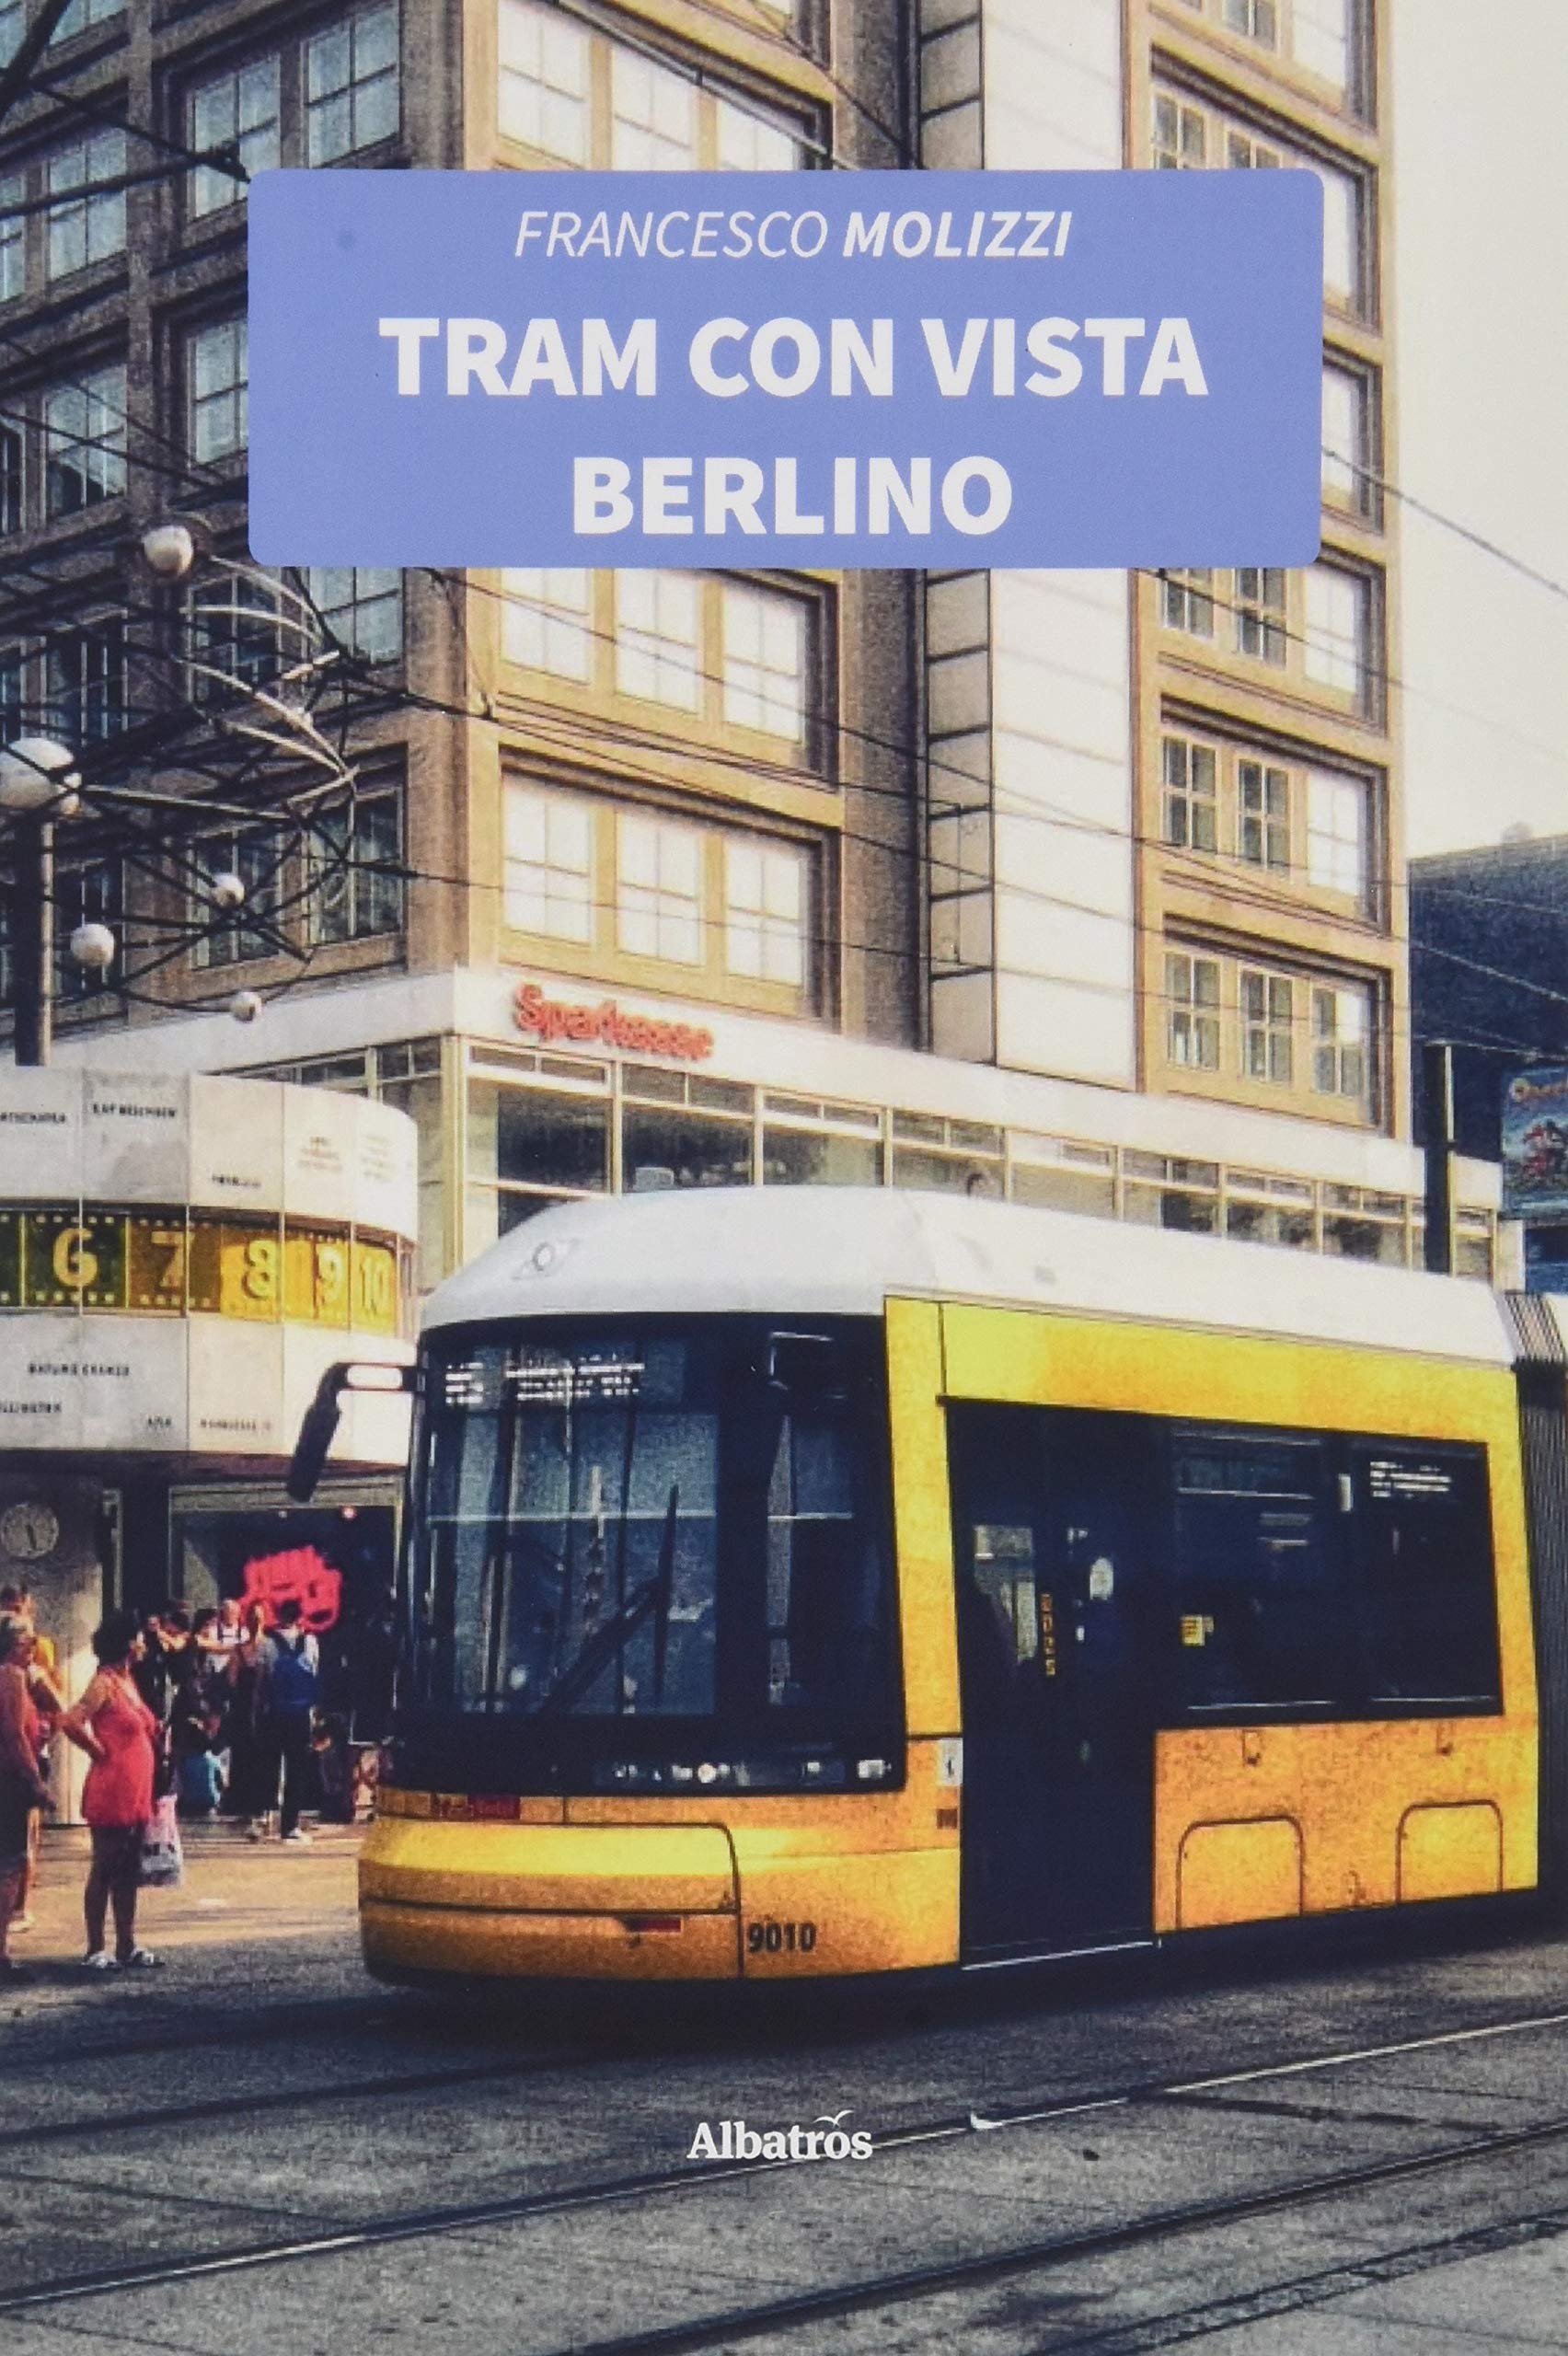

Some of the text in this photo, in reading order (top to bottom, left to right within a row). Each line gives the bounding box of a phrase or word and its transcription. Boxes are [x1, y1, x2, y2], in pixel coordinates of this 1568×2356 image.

[52, 1227, 390, 1316] 6 7 8 9 10
[748, 1922, 817, 1954] 9010
